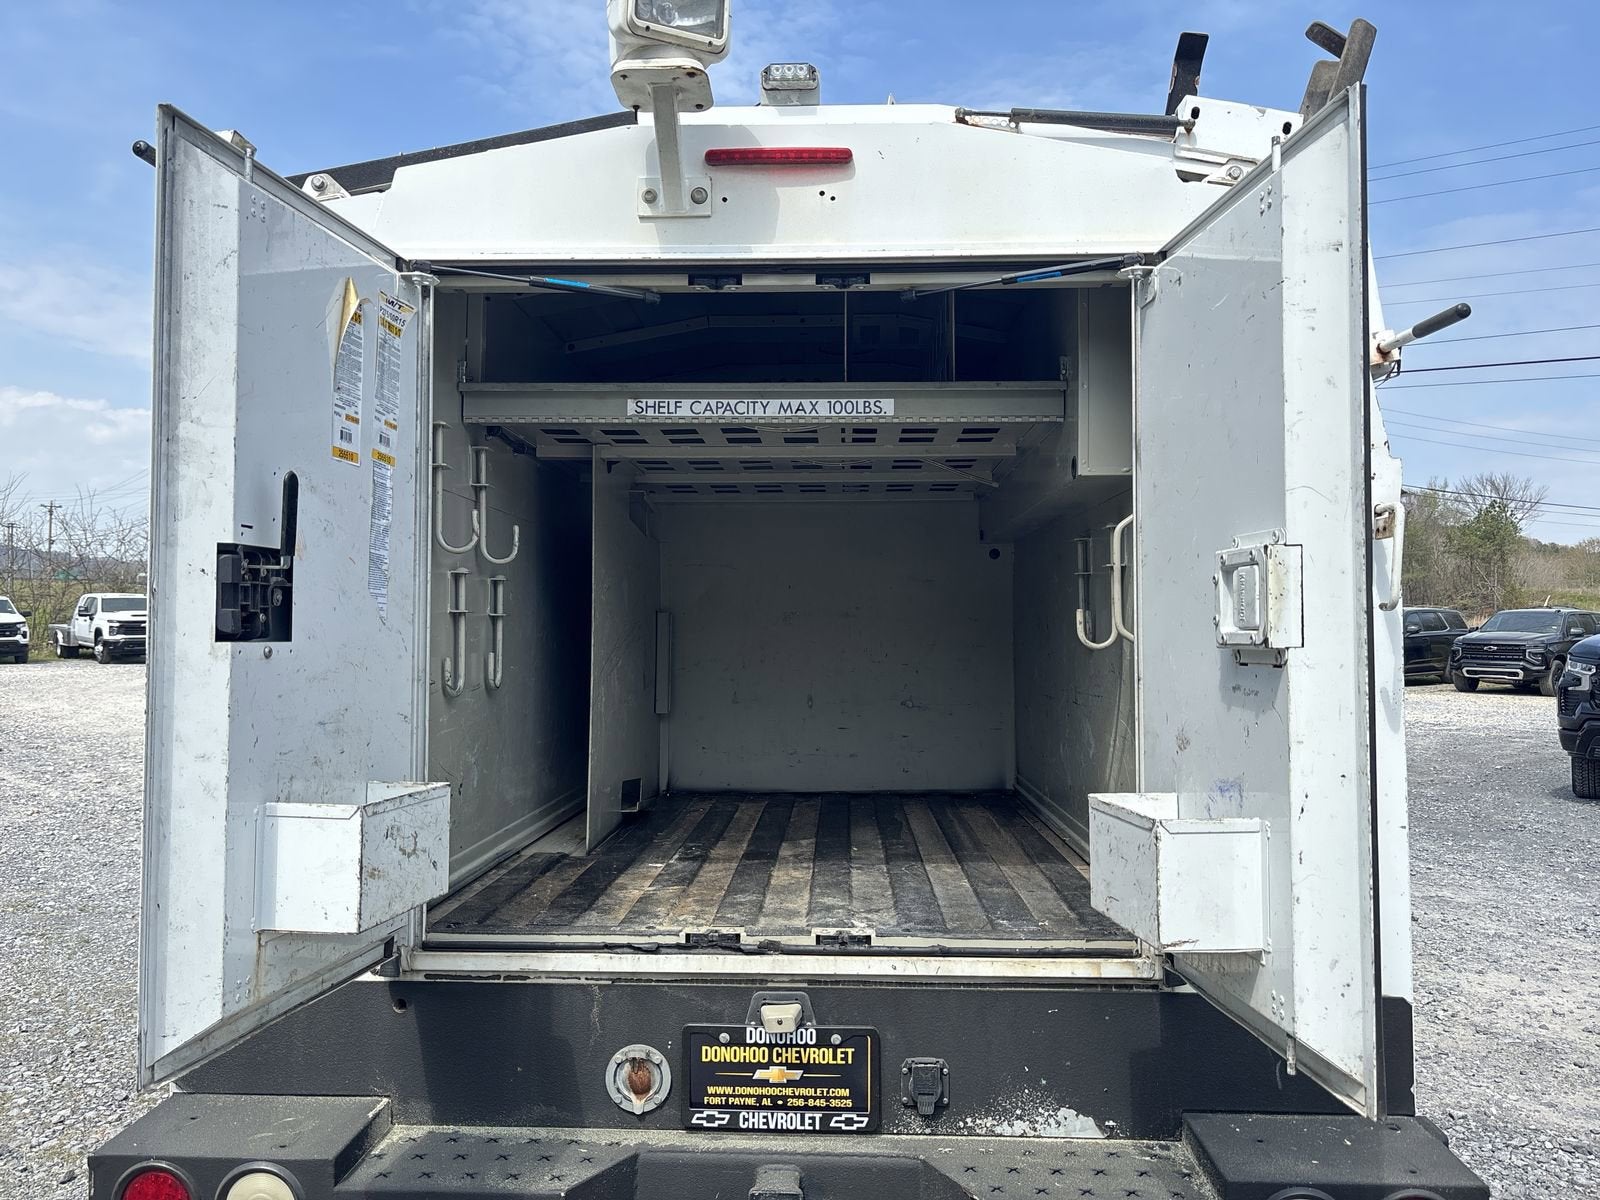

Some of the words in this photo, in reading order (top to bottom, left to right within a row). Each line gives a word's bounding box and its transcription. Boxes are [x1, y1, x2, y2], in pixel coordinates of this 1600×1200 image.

[634, 400, 683, 415] SHELF
[689, 400, 771, 415] CAPACITY
[777, 400, 819, 415] MAX
[827, 400, 887, 415] 100LBS.
[746, 1027, 816, 1044] DONOHOO
[701, 1046, 769, 1063] DONOHOO
[772, 1047, 855, 1064] CHEVROLET
[707, 1086, 850, 1097] WWW.DONOHOOCHEVROLET.COM
[704, 1097, 727, 1105] FORT
[729, 1097, 759, 1106] PAYNE,
[761, 1098, 773, 1106] AL
[787, 1099, 852, 1107] 256-845-3525
[739, 1112, 823, 1130] CHEVROLET
